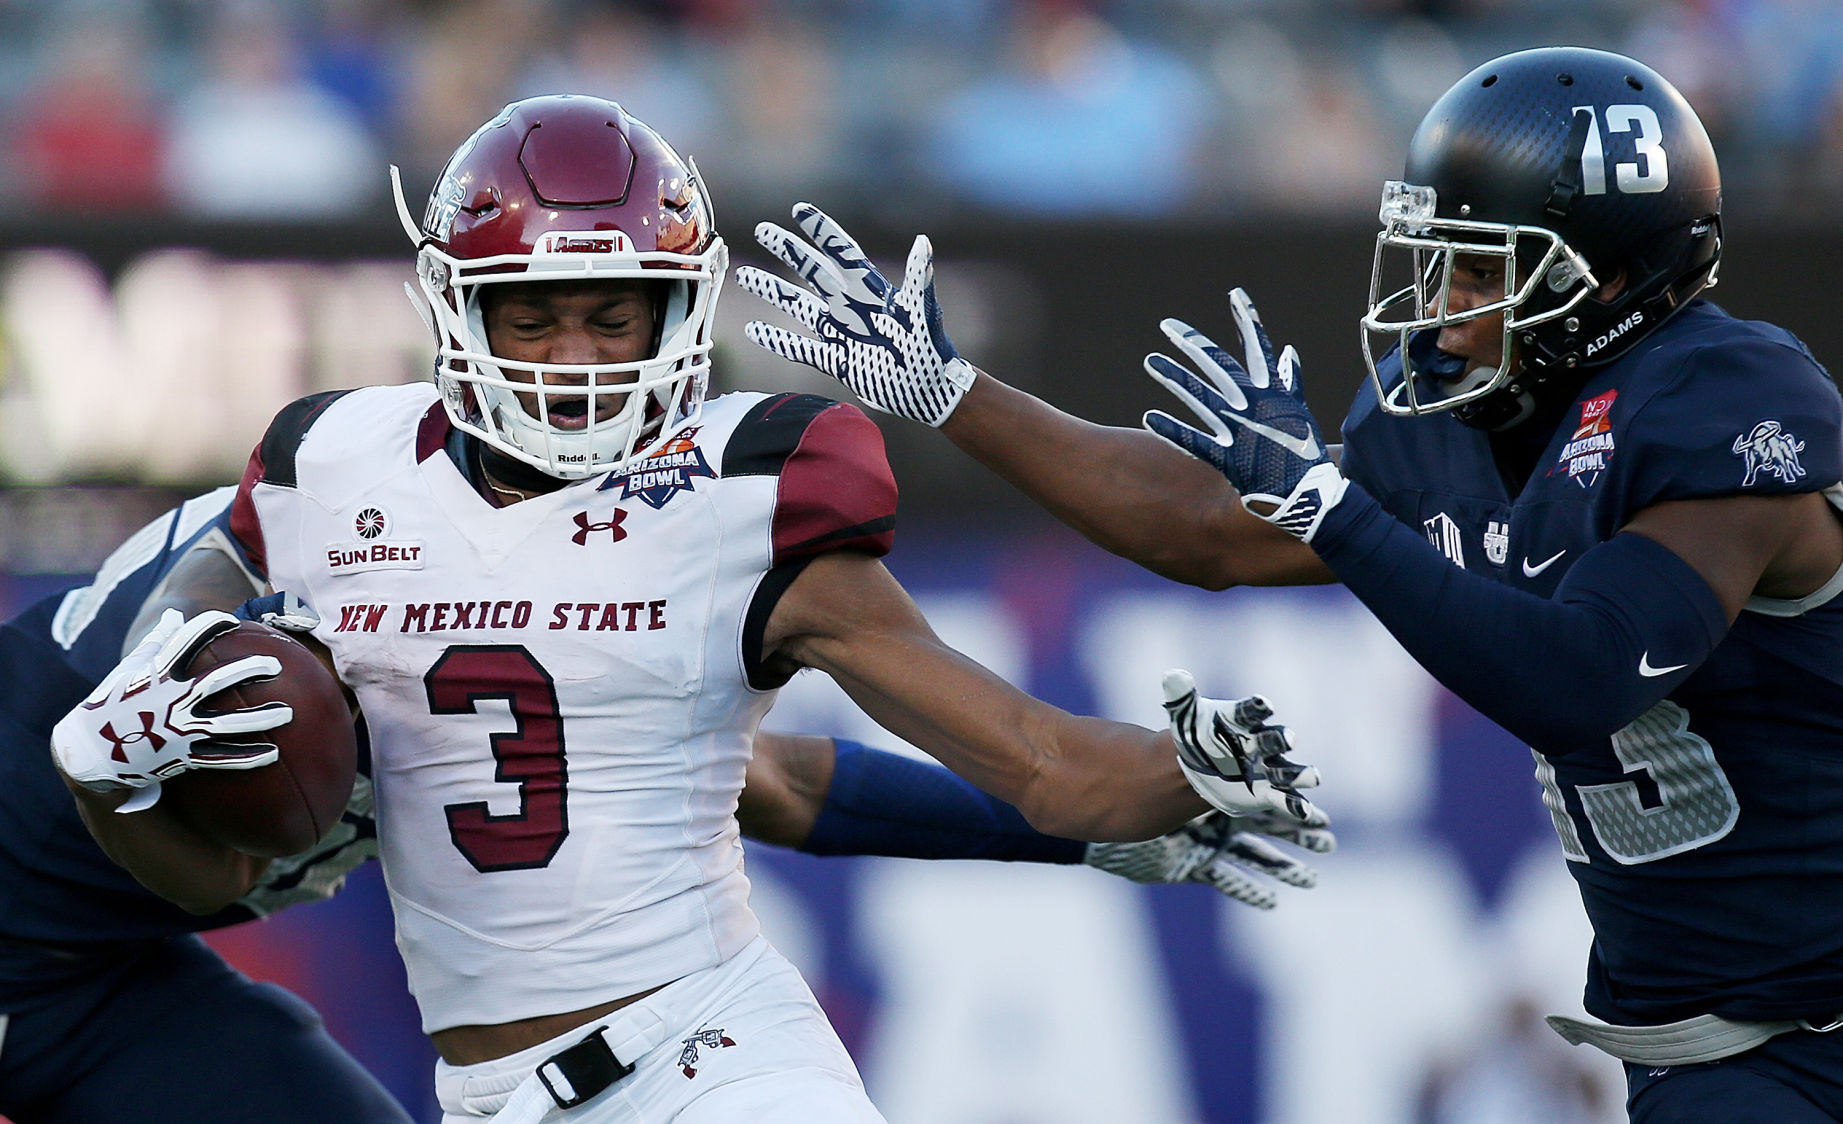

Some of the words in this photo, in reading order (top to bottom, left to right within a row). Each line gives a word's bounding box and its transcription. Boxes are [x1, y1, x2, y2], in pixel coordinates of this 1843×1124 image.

[1571, 104, 1669, 195] 13
[553, 236, 614, 253] AGGIES
[1586, 311, 1644, 357] ADAMS
[1559, 432, 1615, 463] ARIZONA
[612, 450, 700, 479] ARIZONA
[1568, 452, 1606, 477] BOWL
[628, 468, 685, 492] BOWL
[327, 550, 367, 567] SUN
[371, 545, 421, 562] BELT
[400, 601, 533, 633] MEXICO
[548, 599, 667, 632] STATE
[423, 644, 569, 873] 3
